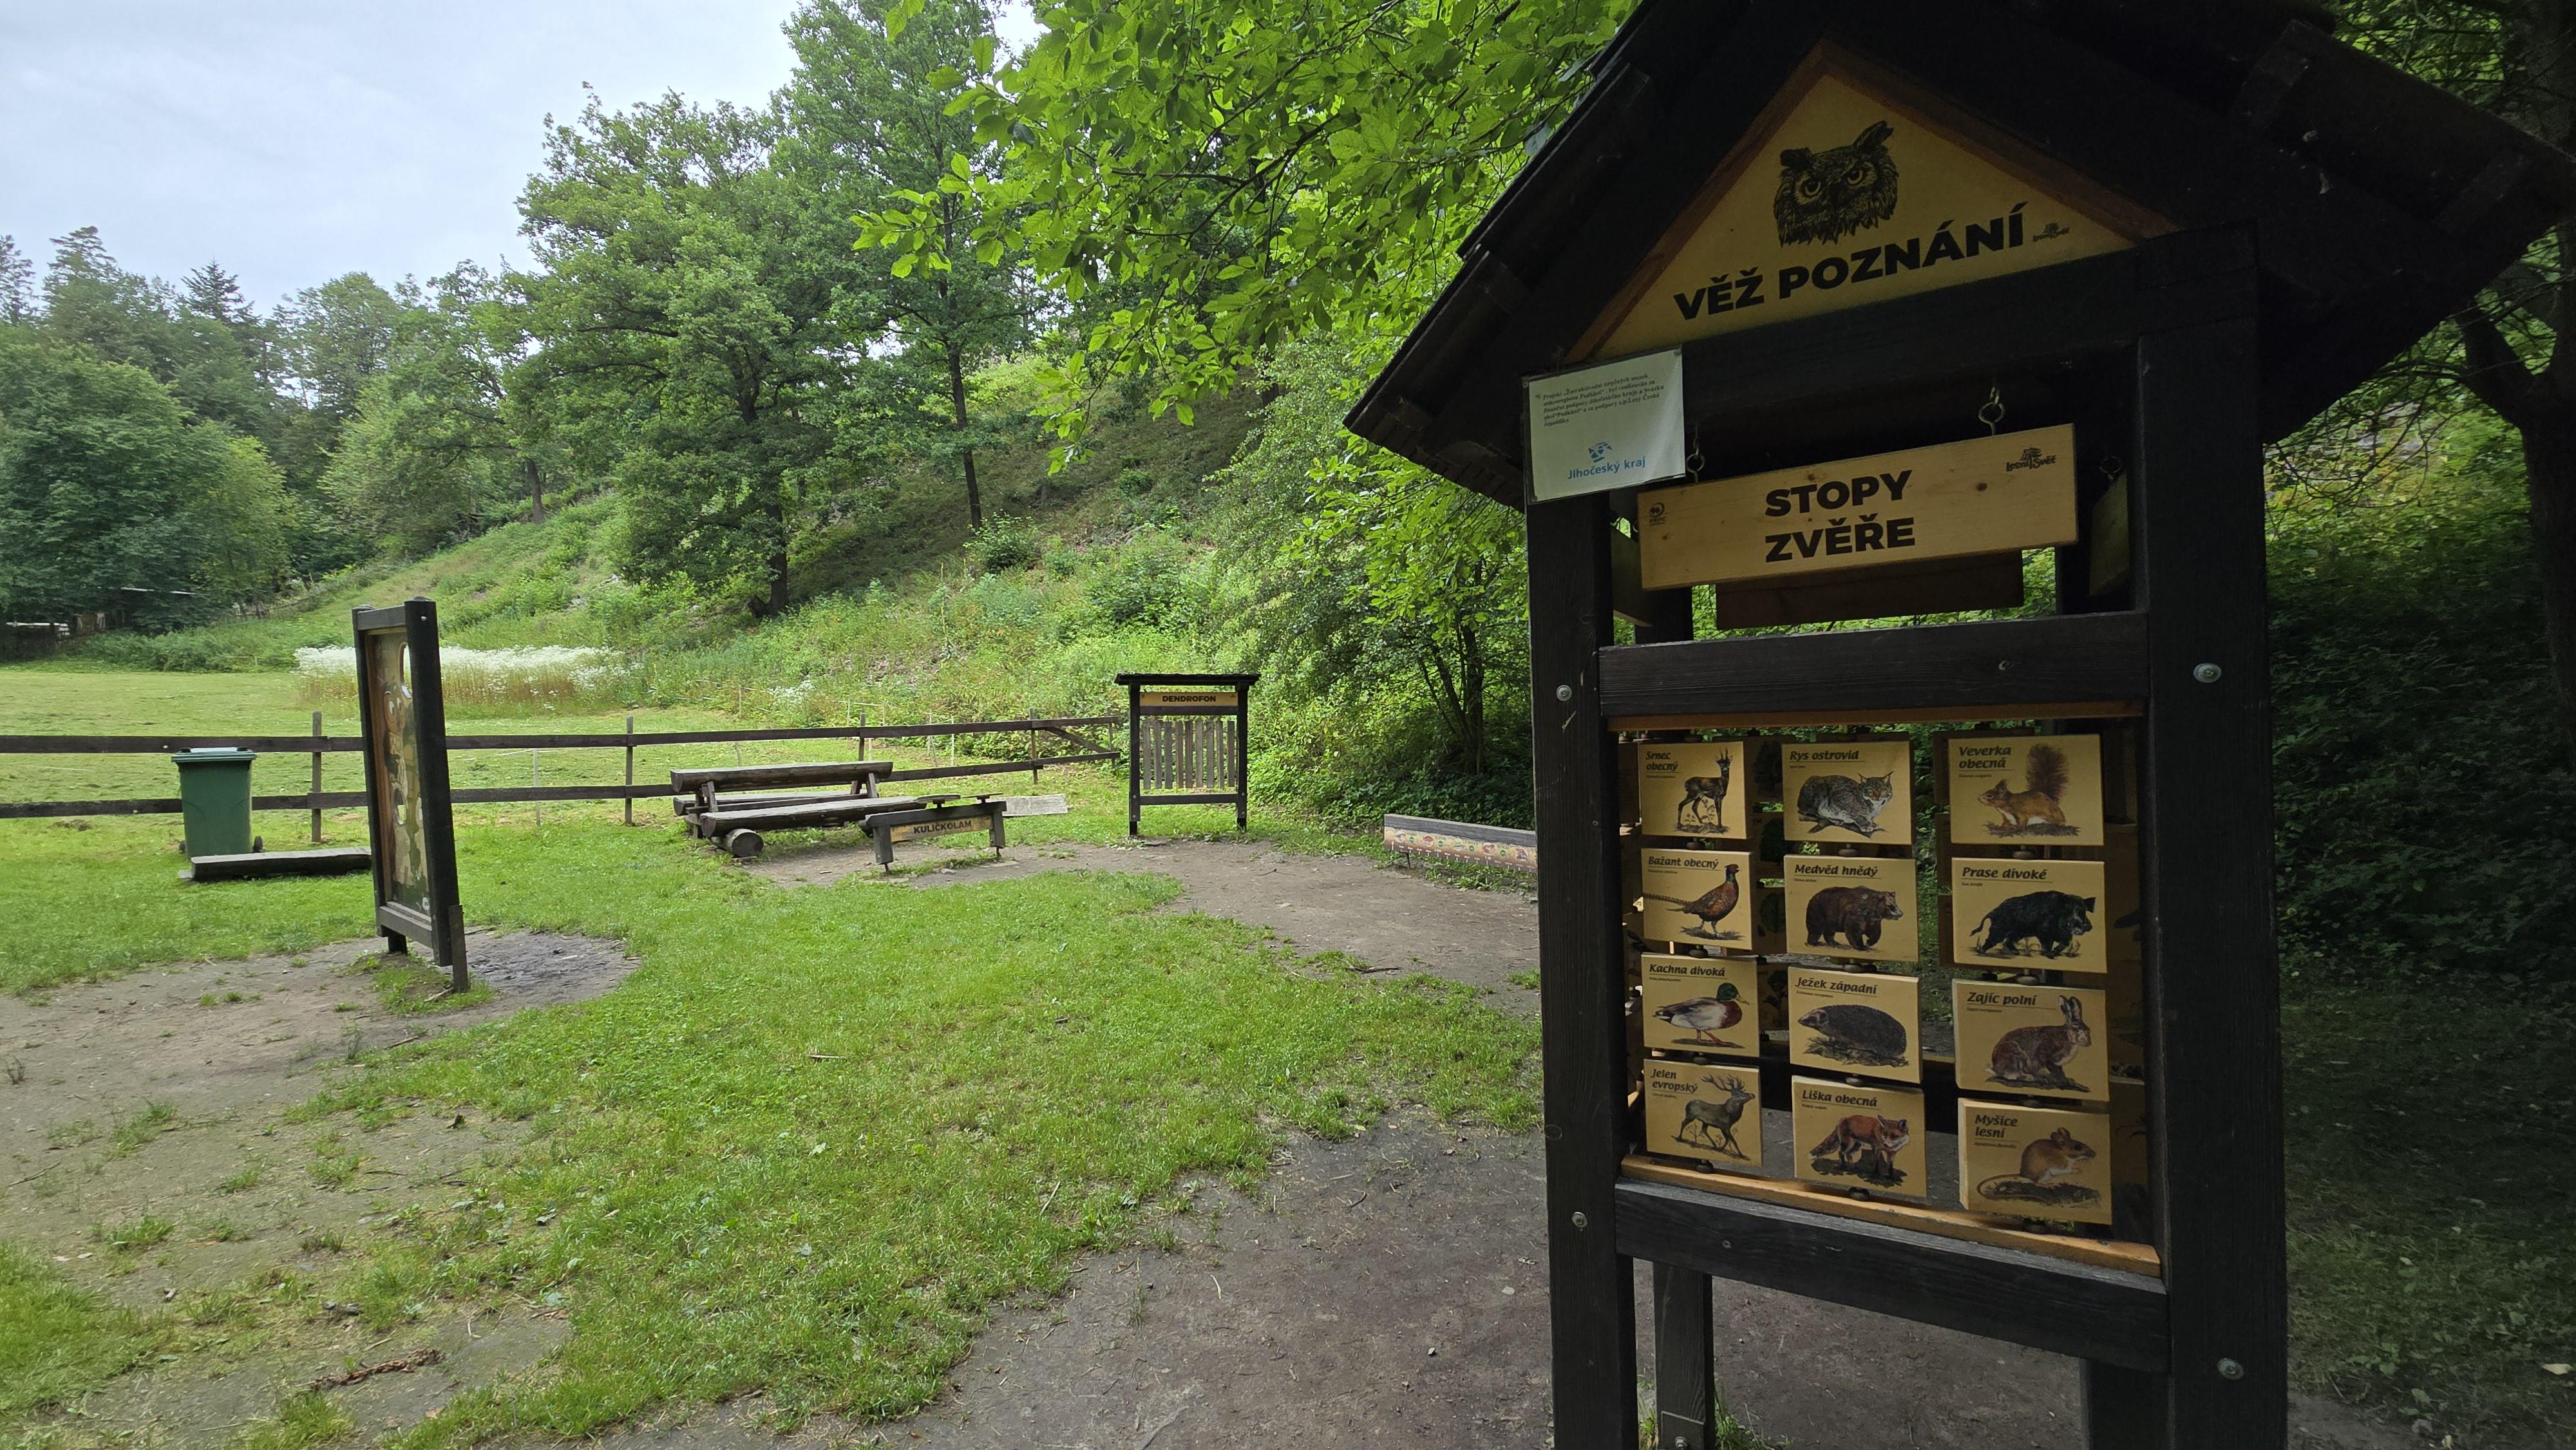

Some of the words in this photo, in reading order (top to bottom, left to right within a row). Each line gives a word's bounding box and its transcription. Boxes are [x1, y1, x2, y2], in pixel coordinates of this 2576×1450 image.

[1674, 267, 1765, 321] VĚŽ
[1779, 201, 2027, 299] POZNÁNÍ
[1568, 461, 1620, 480] Jihočeský
[1624, 456, 1645, 469] kraj
[1765, 470, 1913, 517] STOPY
[1765, 513, 1915, 563] ZVĚŘE
[1645, 751, 1671, 760] Srnec
[1790, 751, 1808, 762] Rys
[1812, 750, 1859, 760] ostrovid
[1959, 746, 2012, 757] Veverka
[1646, 761, 1678, 772] obecný
[1959, 757, 2006, 769] obecná
[914, 820, 972, 834] KULIČKOLAM
[1648, 856, 1681, 866] Bažant
[1684, 858, 1719, 869] obecný
[1795, 864, 1839, 874] Medvěd
[1842, 866, 1879, 878] hnědý
[1962, 867, 1998, 878] Prase
[2002, 869, 2047, 880] divoké
[1649, 964, 1687, 975] Kachna
[1690, 966, 1726, 977] divoká
[1795, 977, 1827, 989] Ježek
[1830, 981, 1879, 995] západní
[1967, 992, 2000, 1005] Zajíc
[2002, 994, 2038, 1006] polní
[1651, 1069, 1676, 1079] Jelen
[1652, 1081, 1698, 1093] evropský
[1802, 1090, 1832, 1101] Liška
[1835, 1095, 1879, 1107] obecná
[1975, 1114, 2018, 1127] Myšice
[1975, 1127, 2006, 1138] lesní
